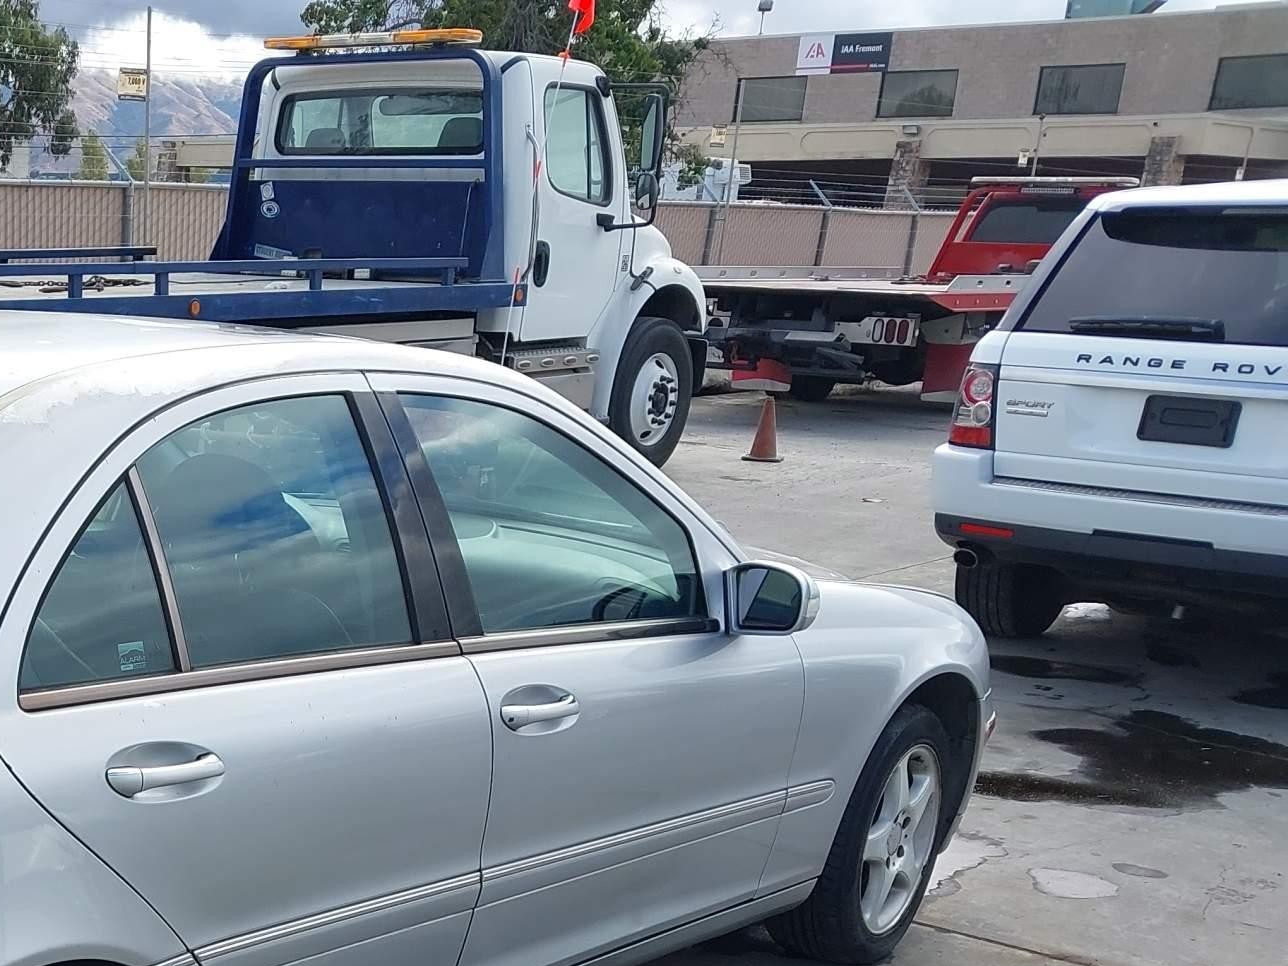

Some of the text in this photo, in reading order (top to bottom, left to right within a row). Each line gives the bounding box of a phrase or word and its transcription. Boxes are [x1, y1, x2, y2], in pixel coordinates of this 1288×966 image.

[841, 44, 883, 54] IAA Fremont
[1076, 353, 1283, 376] RANGE ROV
